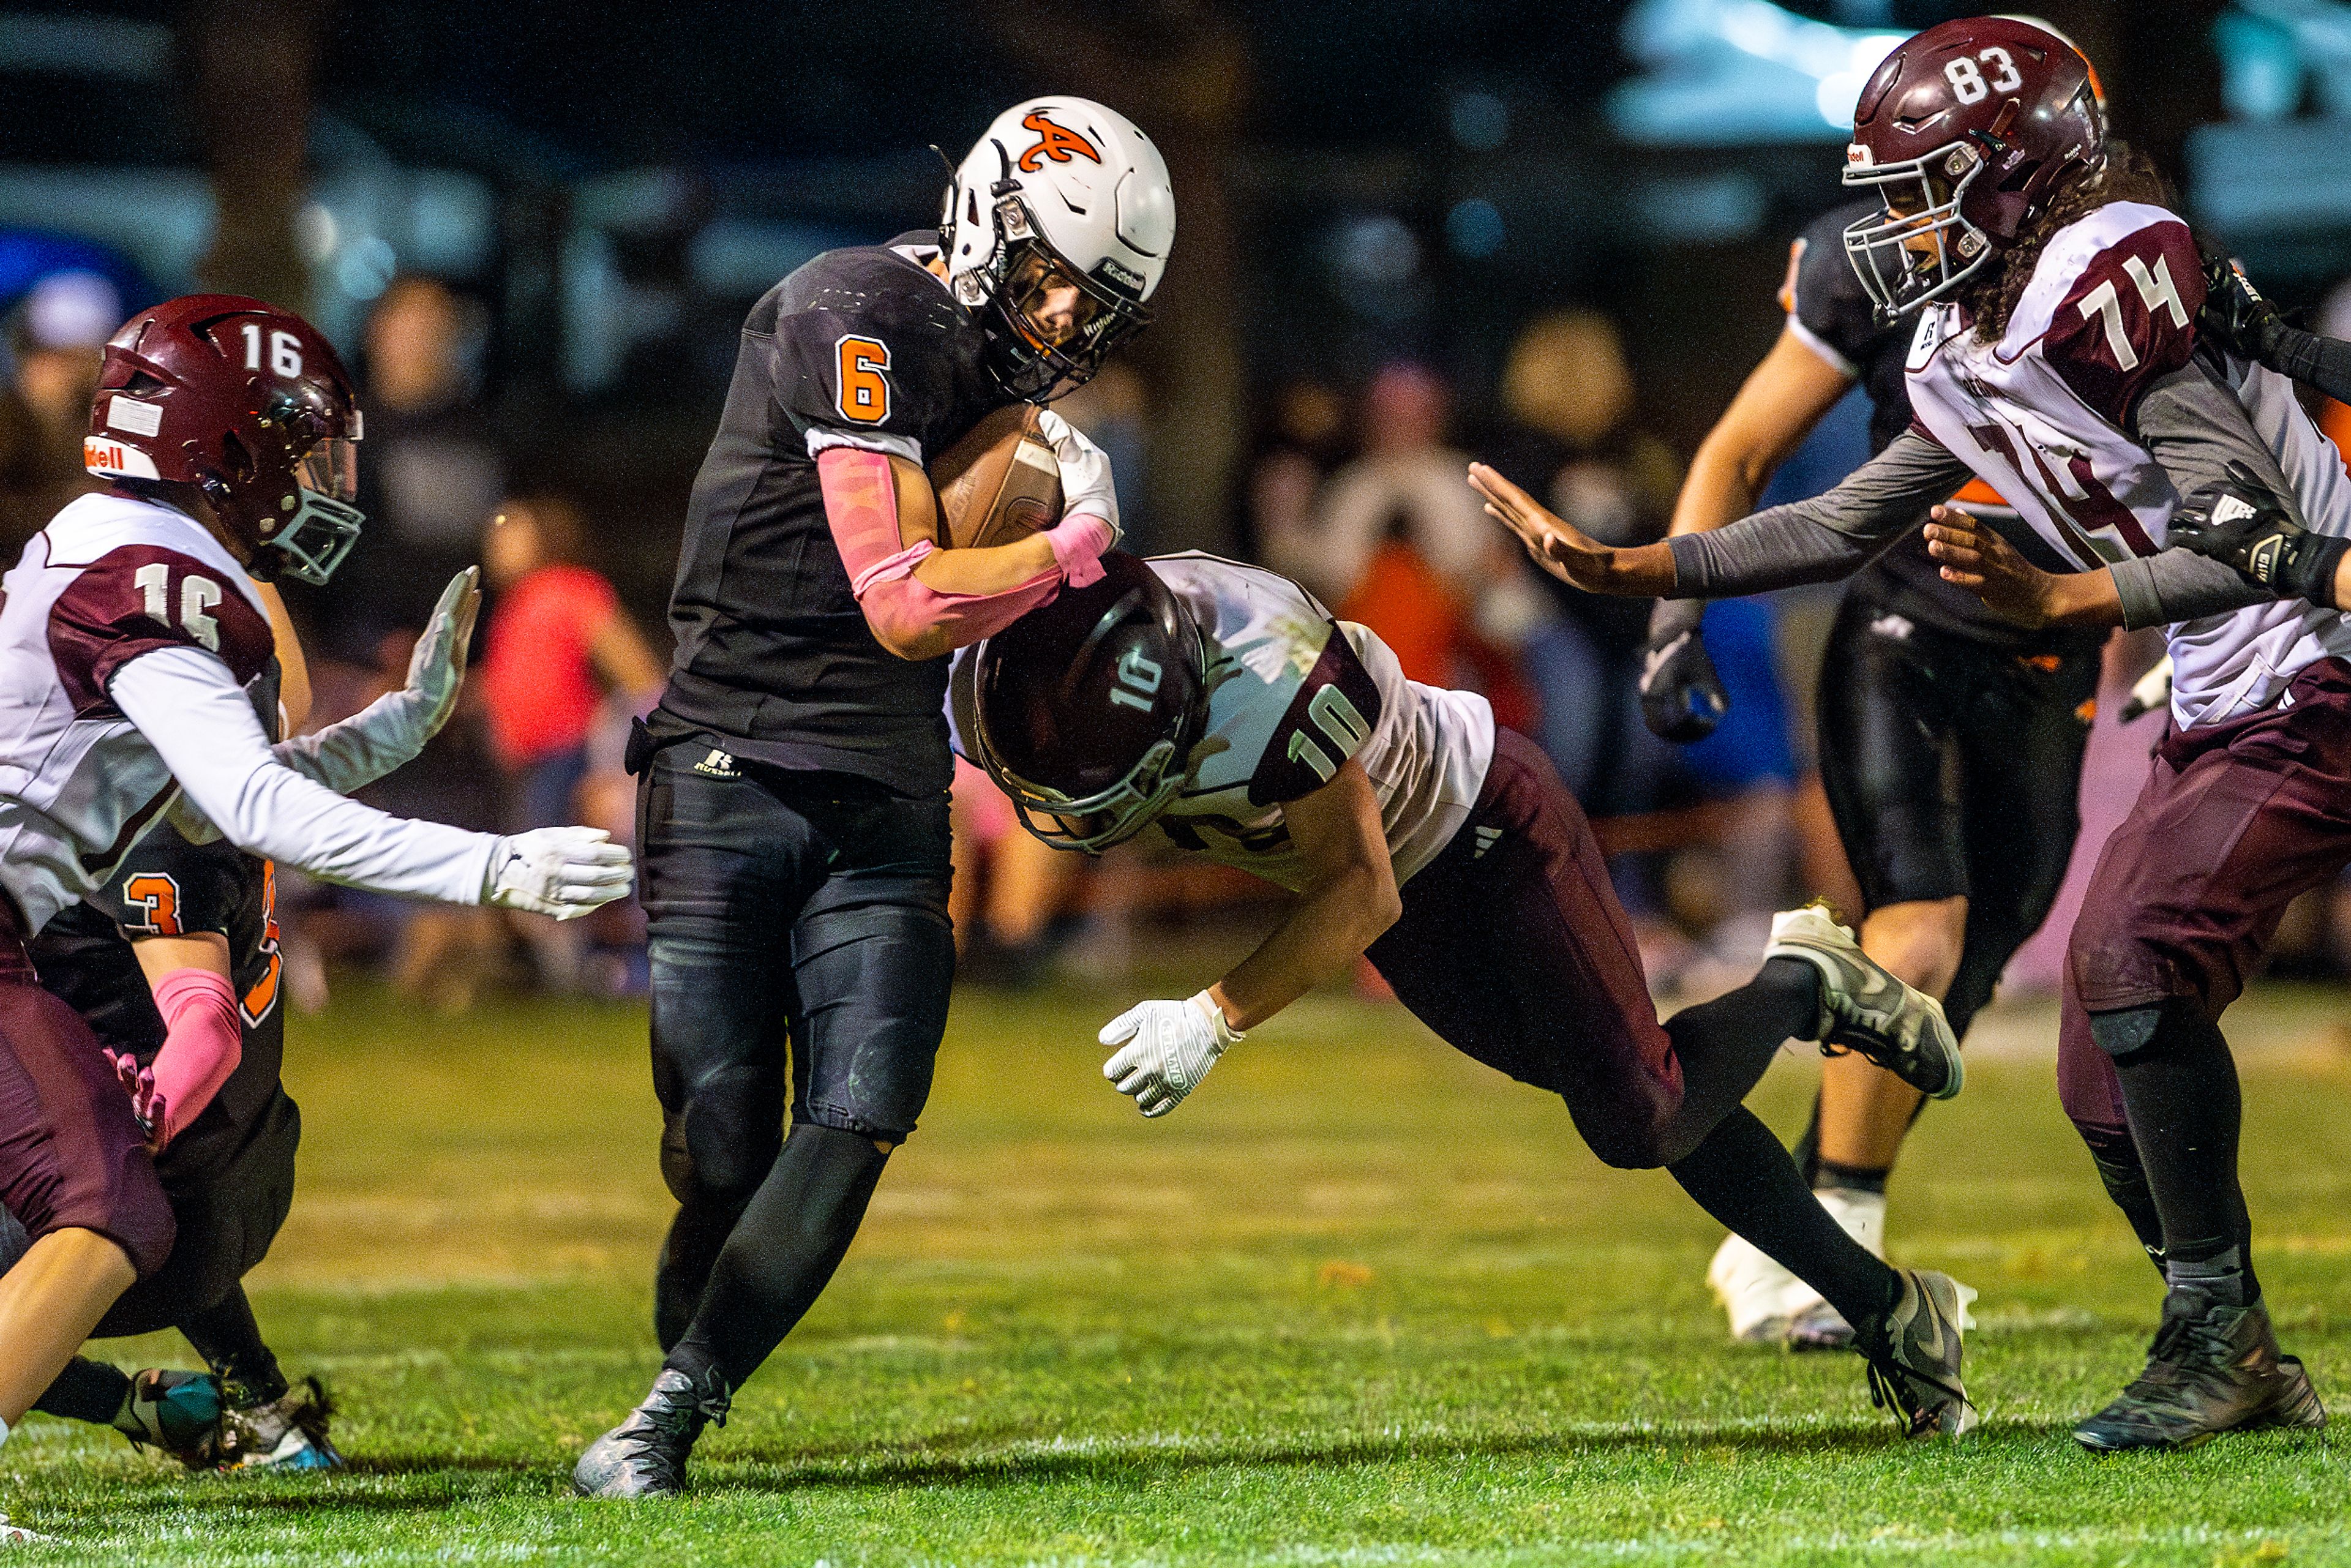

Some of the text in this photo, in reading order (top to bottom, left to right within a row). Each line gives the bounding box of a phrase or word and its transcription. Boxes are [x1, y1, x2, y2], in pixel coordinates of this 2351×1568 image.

[1944, 47, 2021, 105] 83
[242, 325, 302, 378] 16
[2077, 252, 2189, 372] 74
[835, 334, 891, 427] 6
[134, 563, 223, 653] 16
[1287, 683, 1371, 784] 10
